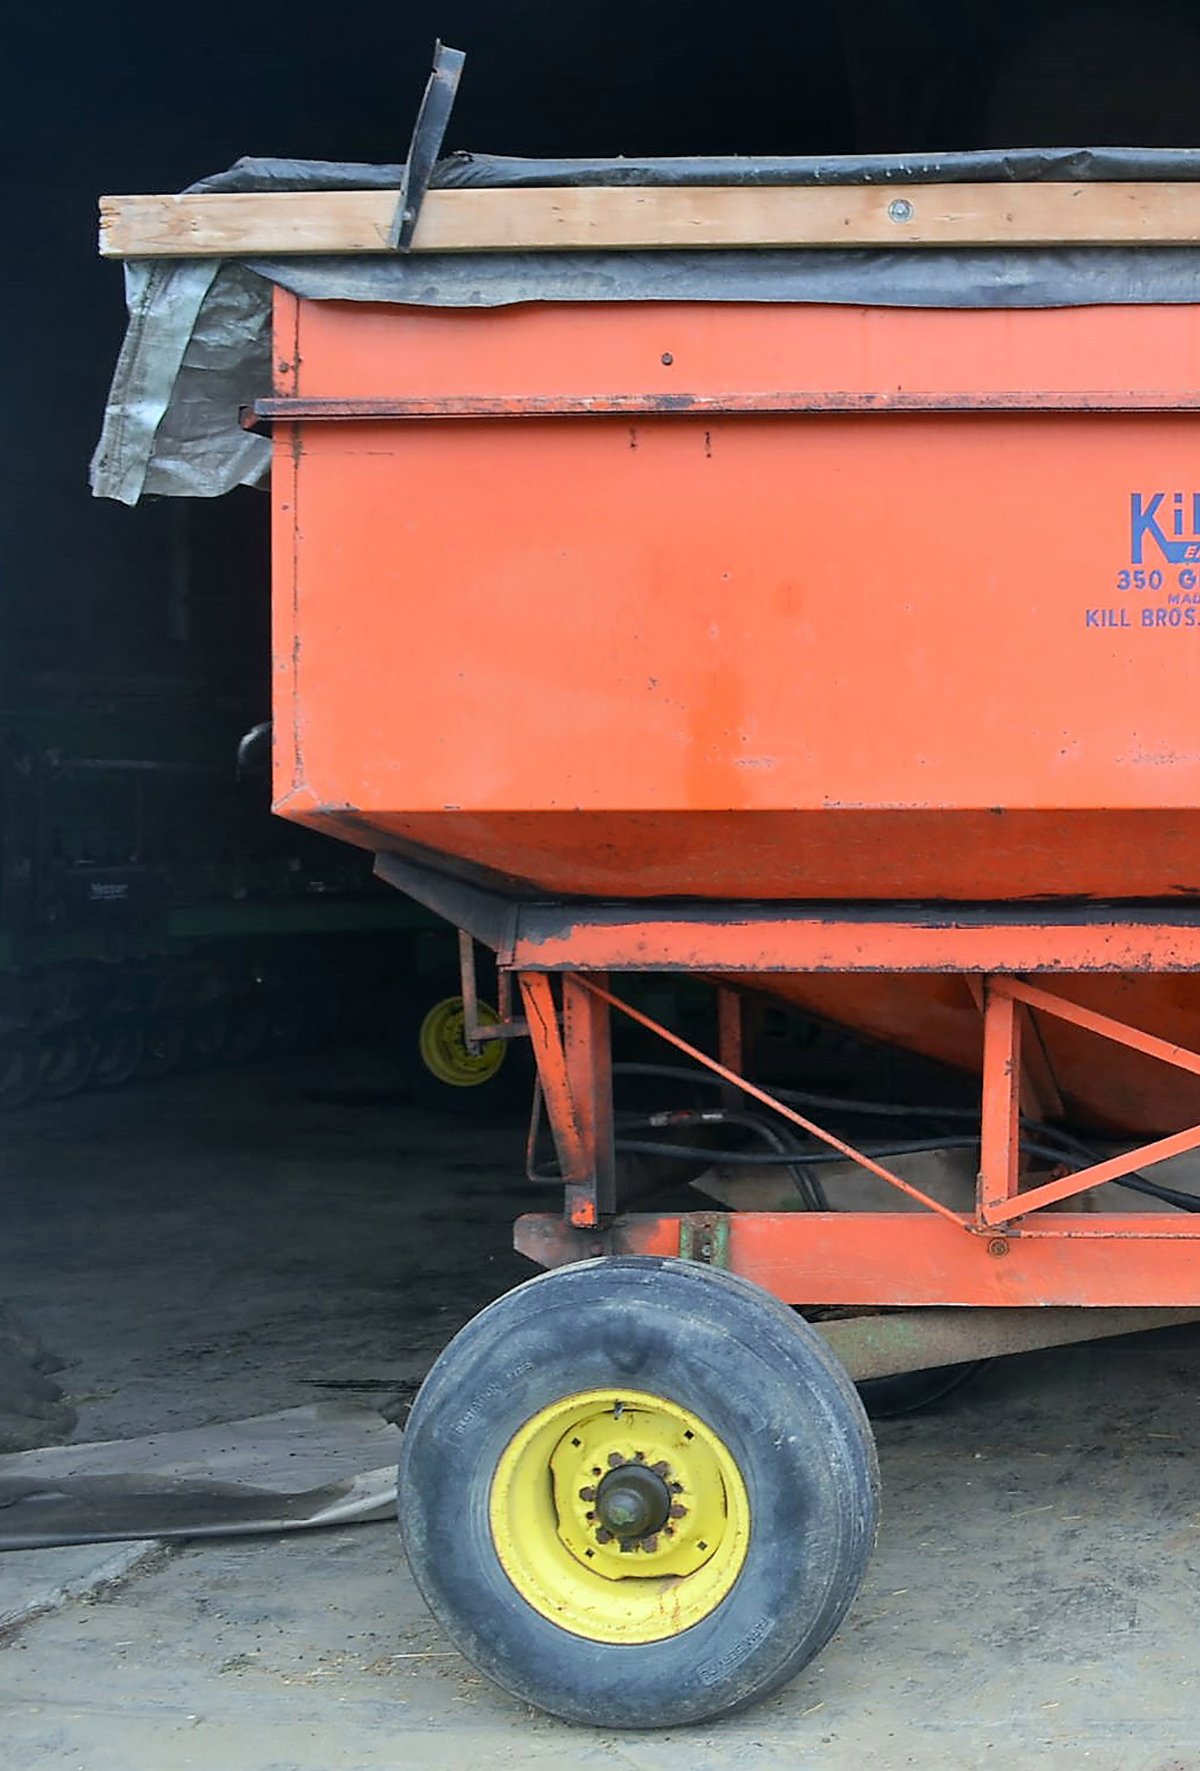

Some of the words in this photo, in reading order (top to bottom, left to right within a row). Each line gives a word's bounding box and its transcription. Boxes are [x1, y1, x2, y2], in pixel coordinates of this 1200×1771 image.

[1116, 570, 1163, 590] 350
[1085, 609, 1131, 627] KILL
[1141, 608, 1200, 627] BROS.
